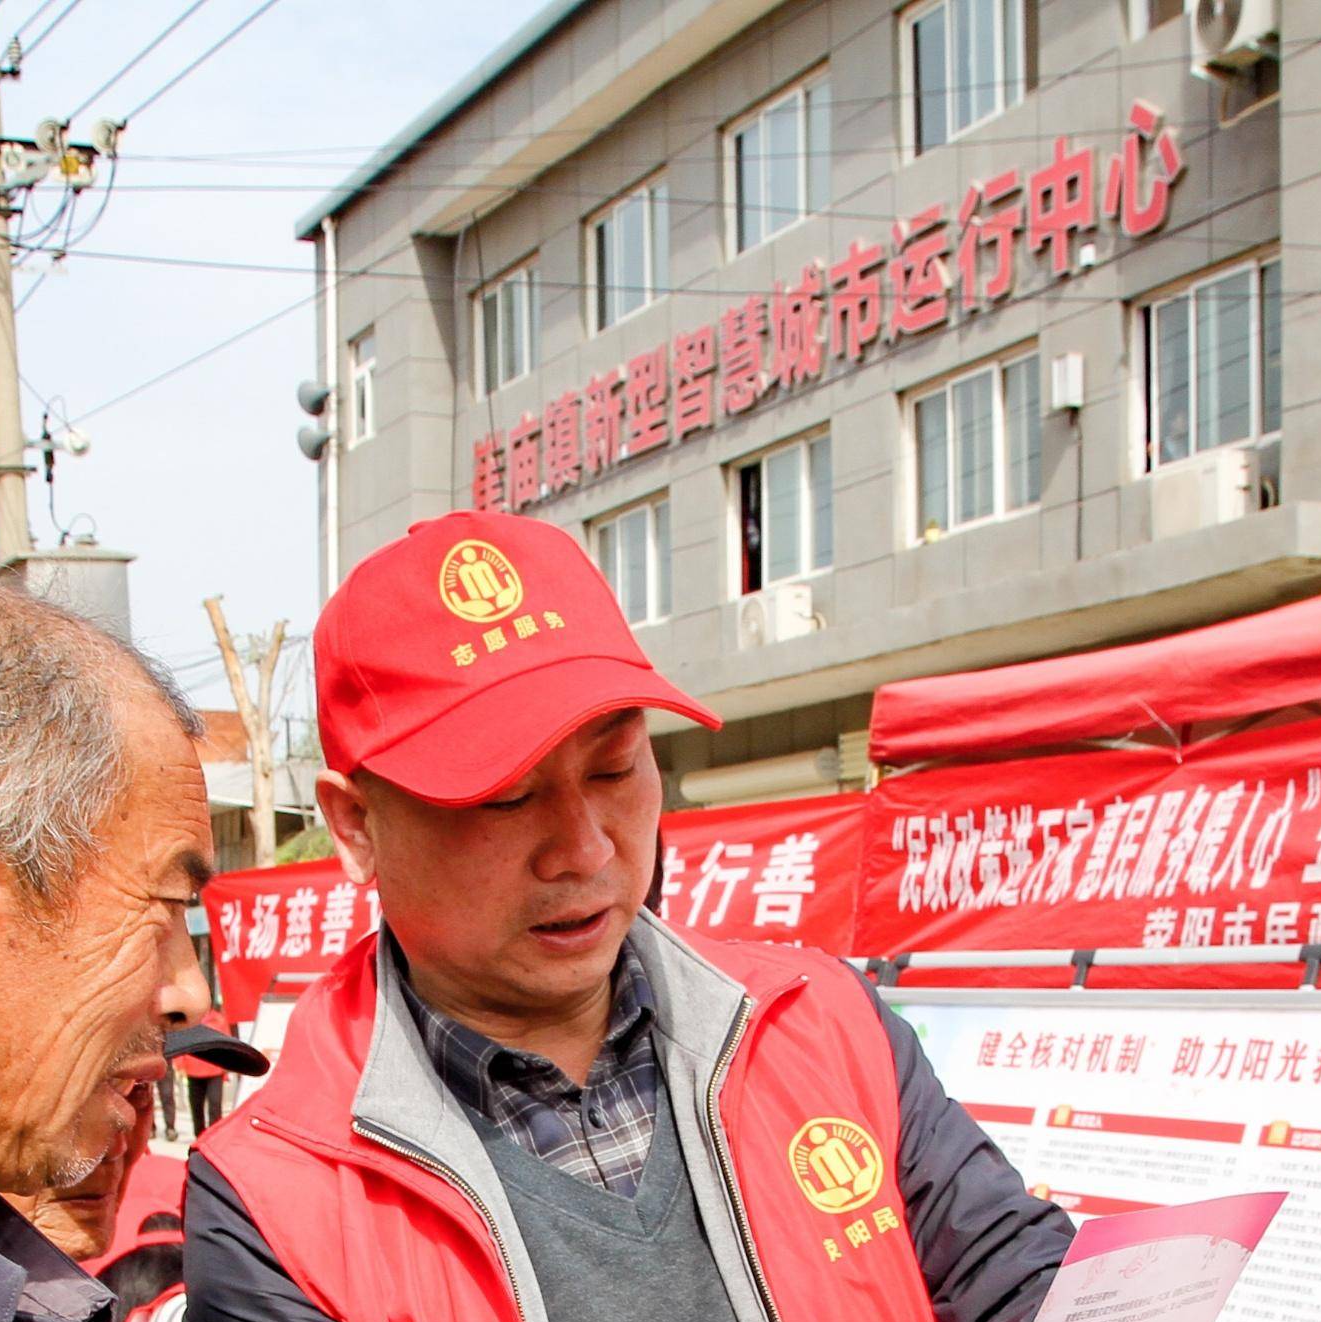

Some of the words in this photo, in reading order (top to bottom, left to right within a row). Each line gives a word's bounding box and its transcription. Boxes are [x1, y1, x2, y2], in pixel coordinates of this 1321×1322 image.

[451, 610, 566, 667] 志愿服务
[219, 881, 384, 963] 弘扬慈善
[977, 1030, 1147, 1076] 健全核对机制
